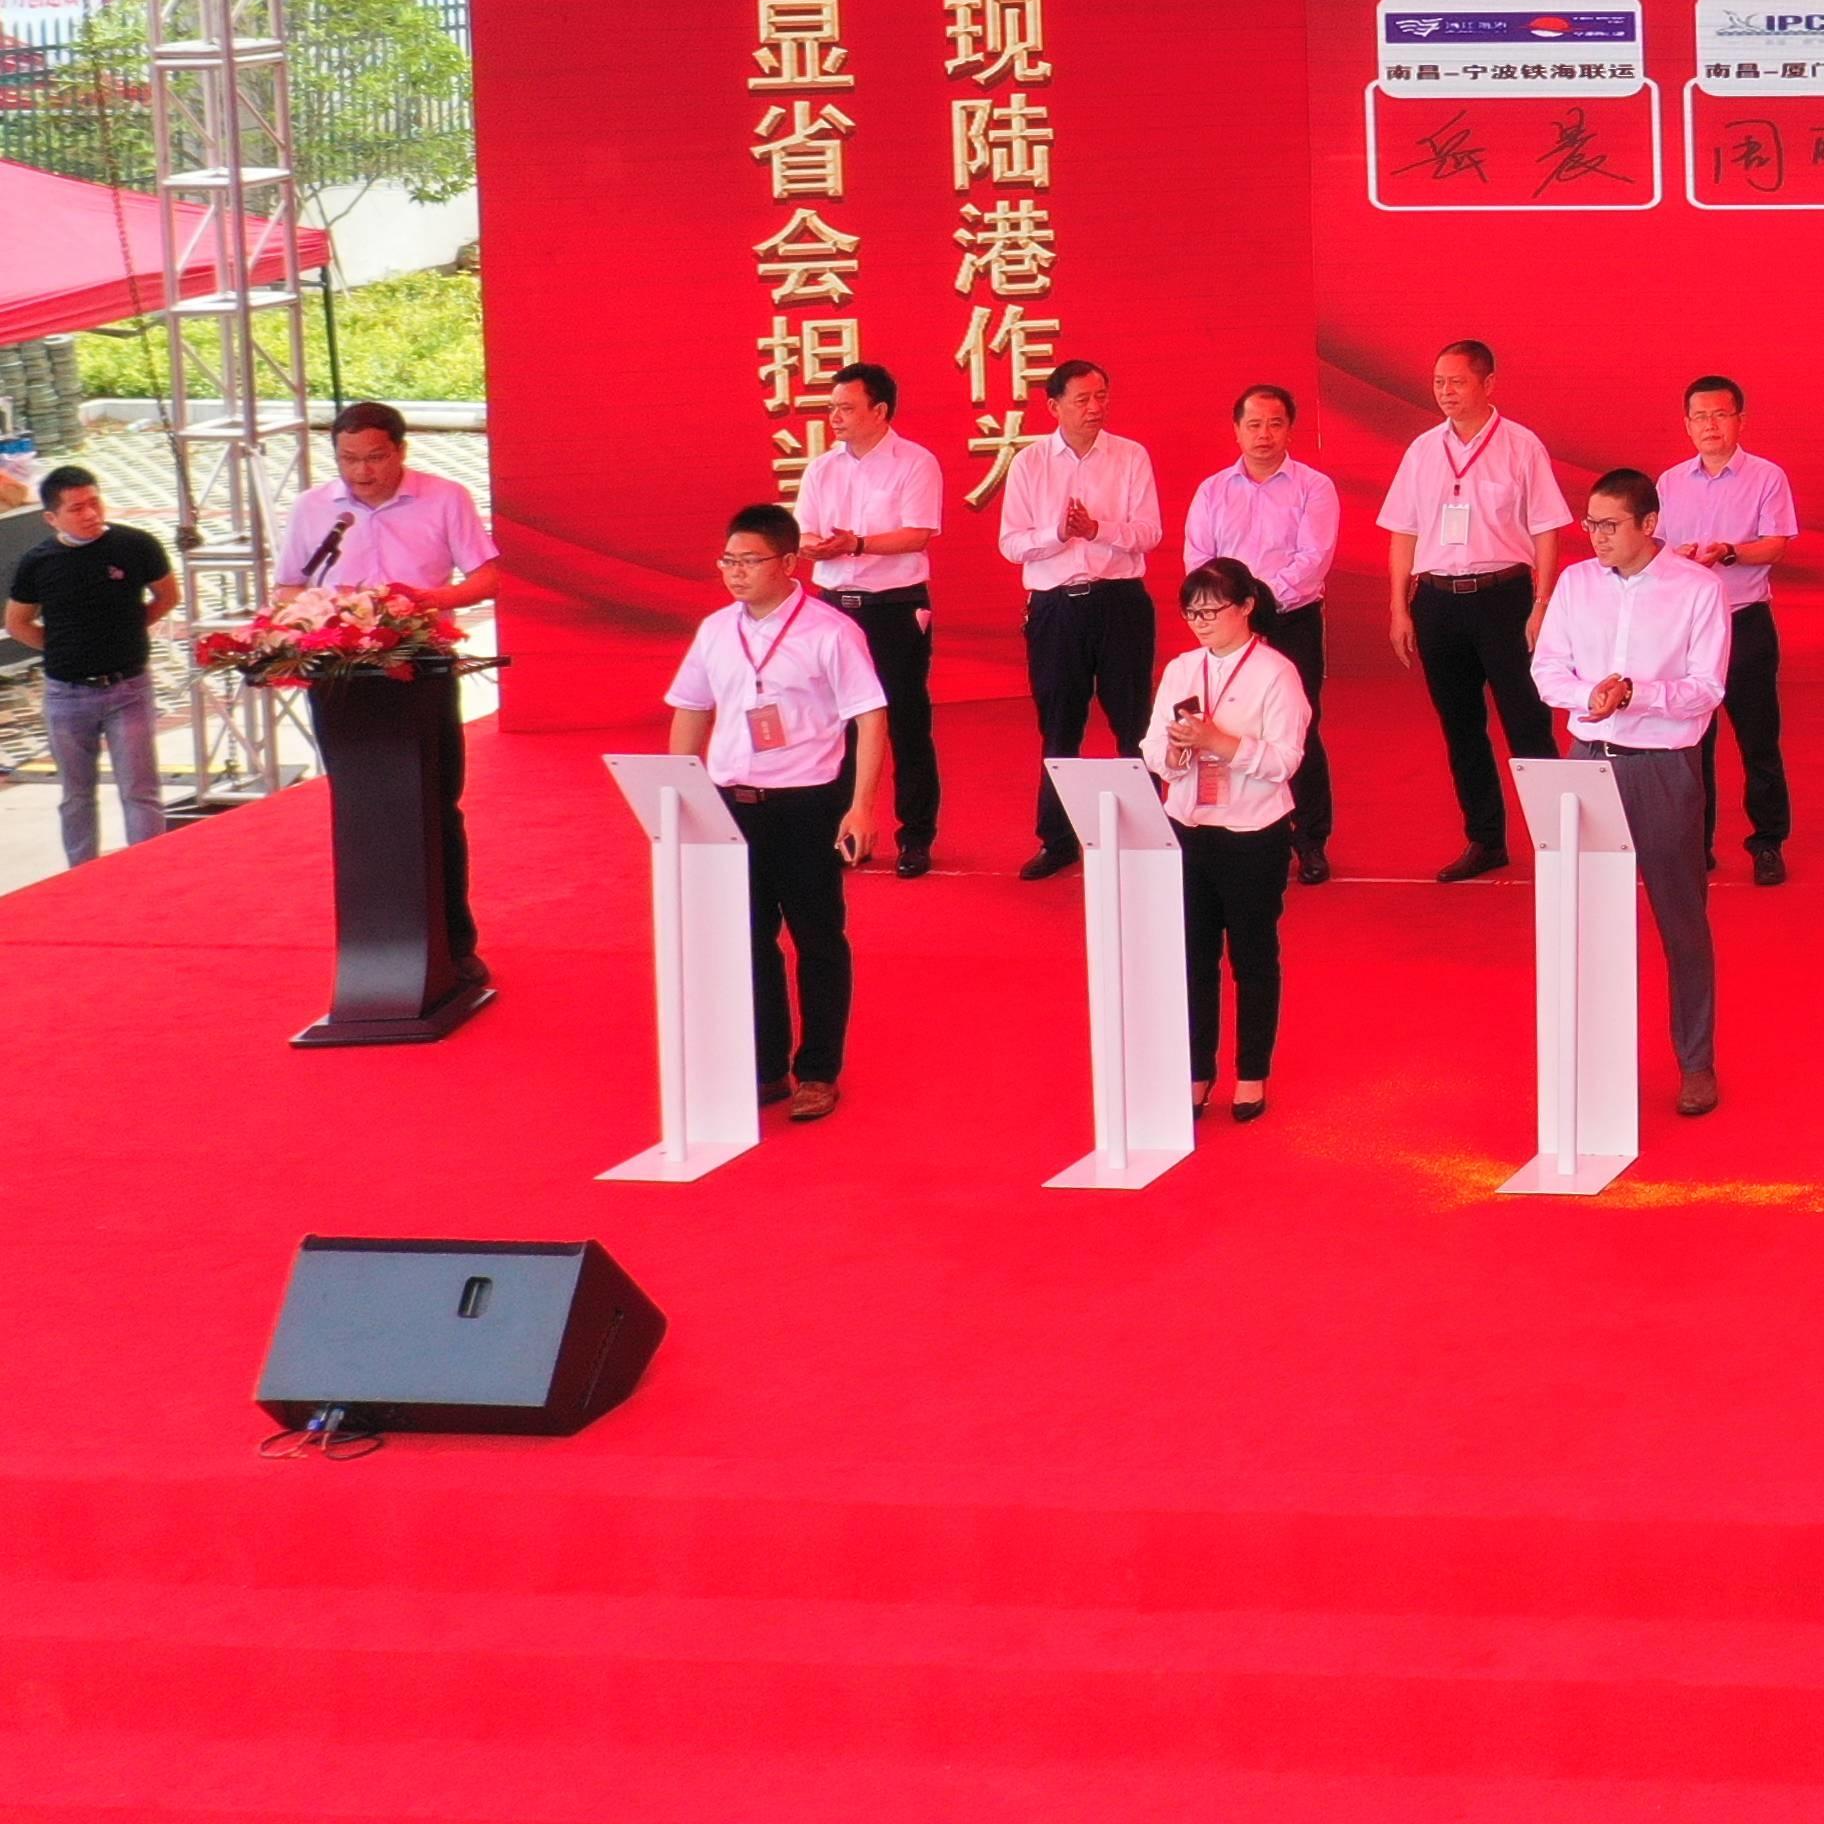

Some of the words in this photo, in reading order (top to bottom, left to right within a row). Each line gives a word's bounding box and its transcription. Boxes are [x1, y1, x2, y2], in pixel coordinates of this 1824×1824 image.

[1386, 63, 1637, 81] 南昌-宁波铁海联运
